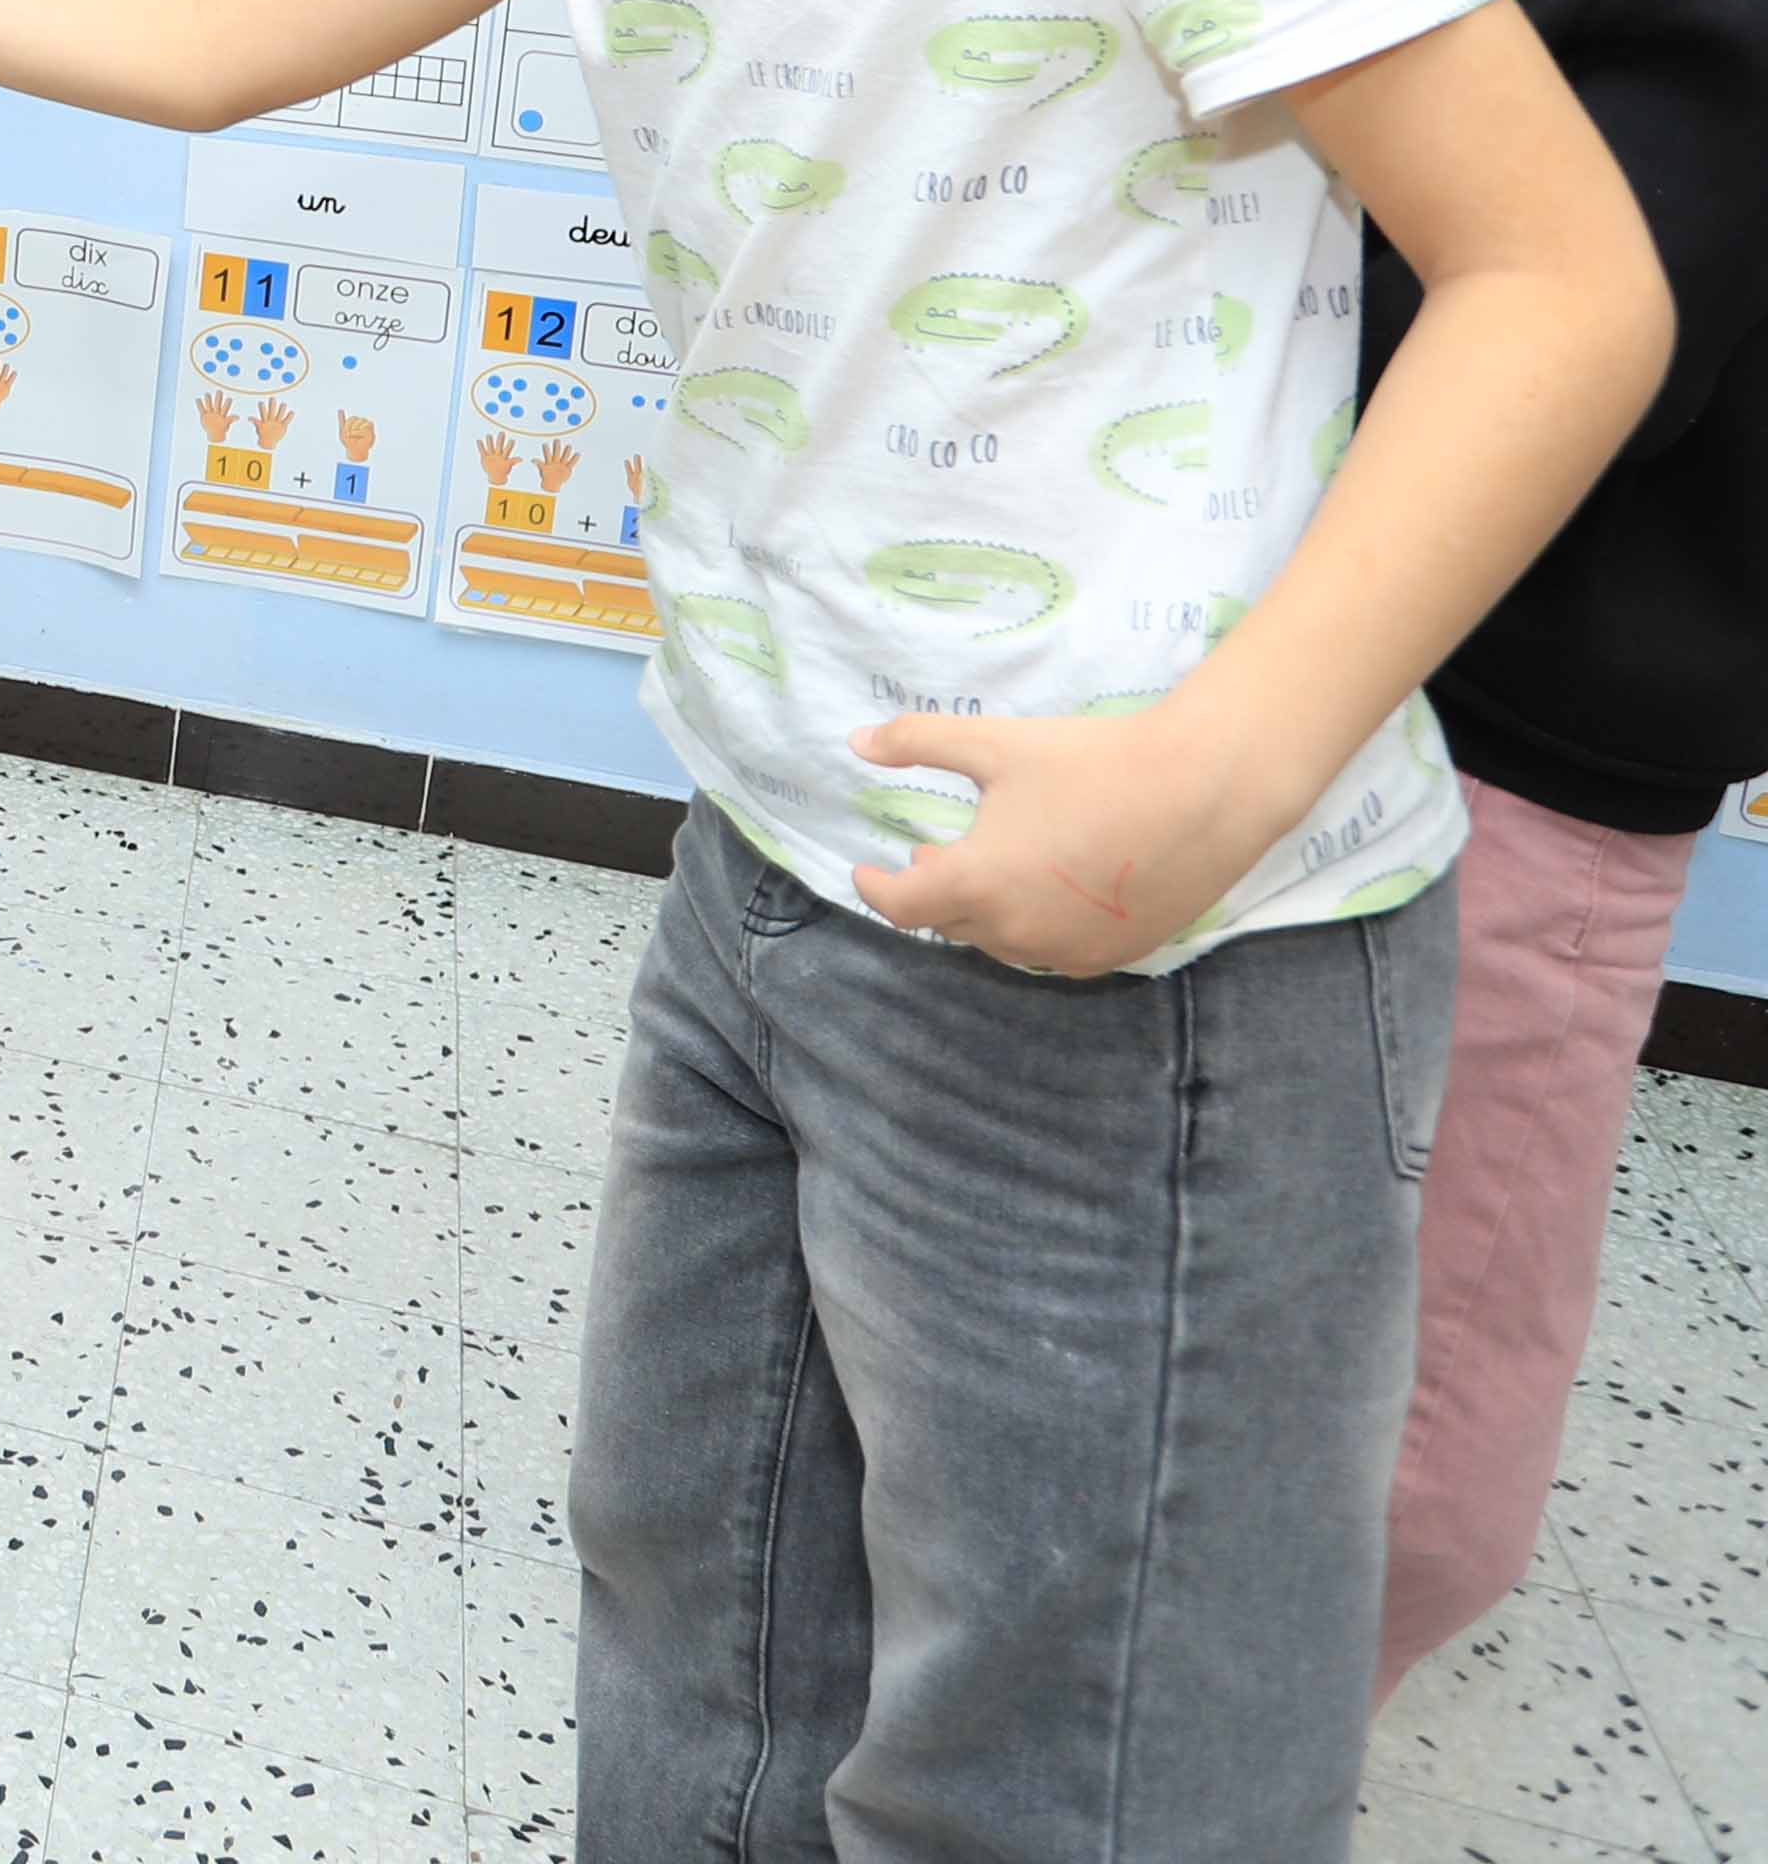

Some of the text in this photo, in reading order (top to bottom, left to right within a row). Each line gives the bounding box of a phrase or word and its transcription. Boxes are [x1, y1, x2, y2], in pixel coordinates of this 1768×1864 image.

[746, 60, 769, 87] LE
[913, 164, 1030, 204] CRO CO CO
[296, 193, 347, 215] un
[569, 214, 632, 249] deu
[68, 239, 109, 268] dix
[61, 265, 110, 296] dix
[213, 267, 410, 309] 11 onze
[714, 308, 735, 331] LE
[1295, 285, 1350, 321] RO CO
[334, 310, 406, 352] onze
[496, 305, 664, 349] 12 do
[1154, 319, 1174, 349] LE
[616, 340, 680, 372] dou
[885, 423, 999, 469] CRO CO CO
[215, 454, 263, 482] 10
[345, 472, 358, 497] 1
[496, 498, 546, 526] 10
[1130, 599, 1154, 632] LE
[871, 672, 907, 706] CRO
[1338, 814, 1363, 852] CO
[1362, 790, 1385, 829] CO
